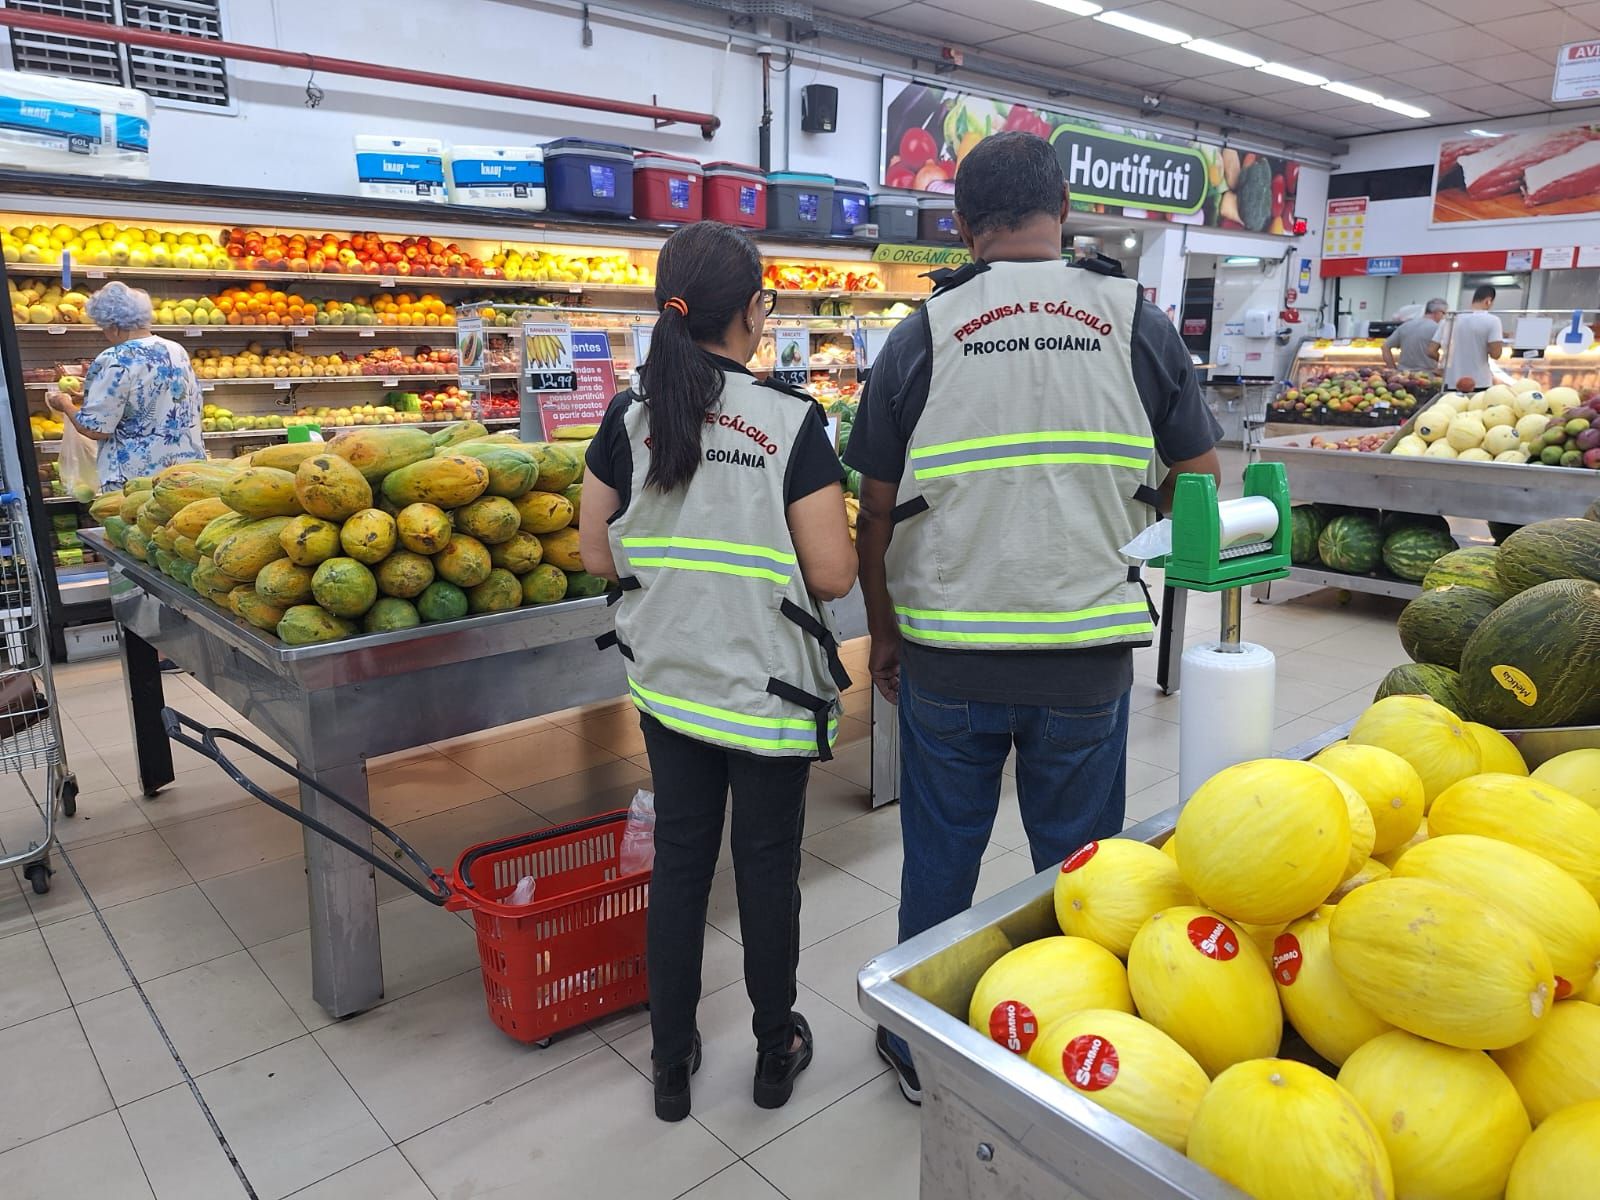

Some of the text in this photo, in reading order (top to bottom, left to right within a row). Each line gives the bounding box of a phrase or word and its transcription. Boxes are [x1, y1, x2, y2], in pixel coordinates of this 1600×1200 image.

[1575, 45, 1600, 58] AVI
[1069, 143, 1191, 200] Hortifrúti
[893, 249, 970, 265] ORGÂNICOS
[954, 300, 1112, 342] PESQUISA E CÁLCULO
[573, 342, 601, 353] entes
[963, 335, 1101, 356] PROCON GOIÂNIA
[572, 392, 605, 401] Hortifrúti
[559, 411, 580, 421] partir
[581, 410, 595, 418] das
[705, 413, 777, 455] E CÁLCULO
[706, 449, 766, 468] GOIÂNIA
[1200, 923, 1225, 954] SUMMO
[1007, 1004, 1021, 1050] SUMMO
[1076, 1038, 1102, 1086] SUMMO
